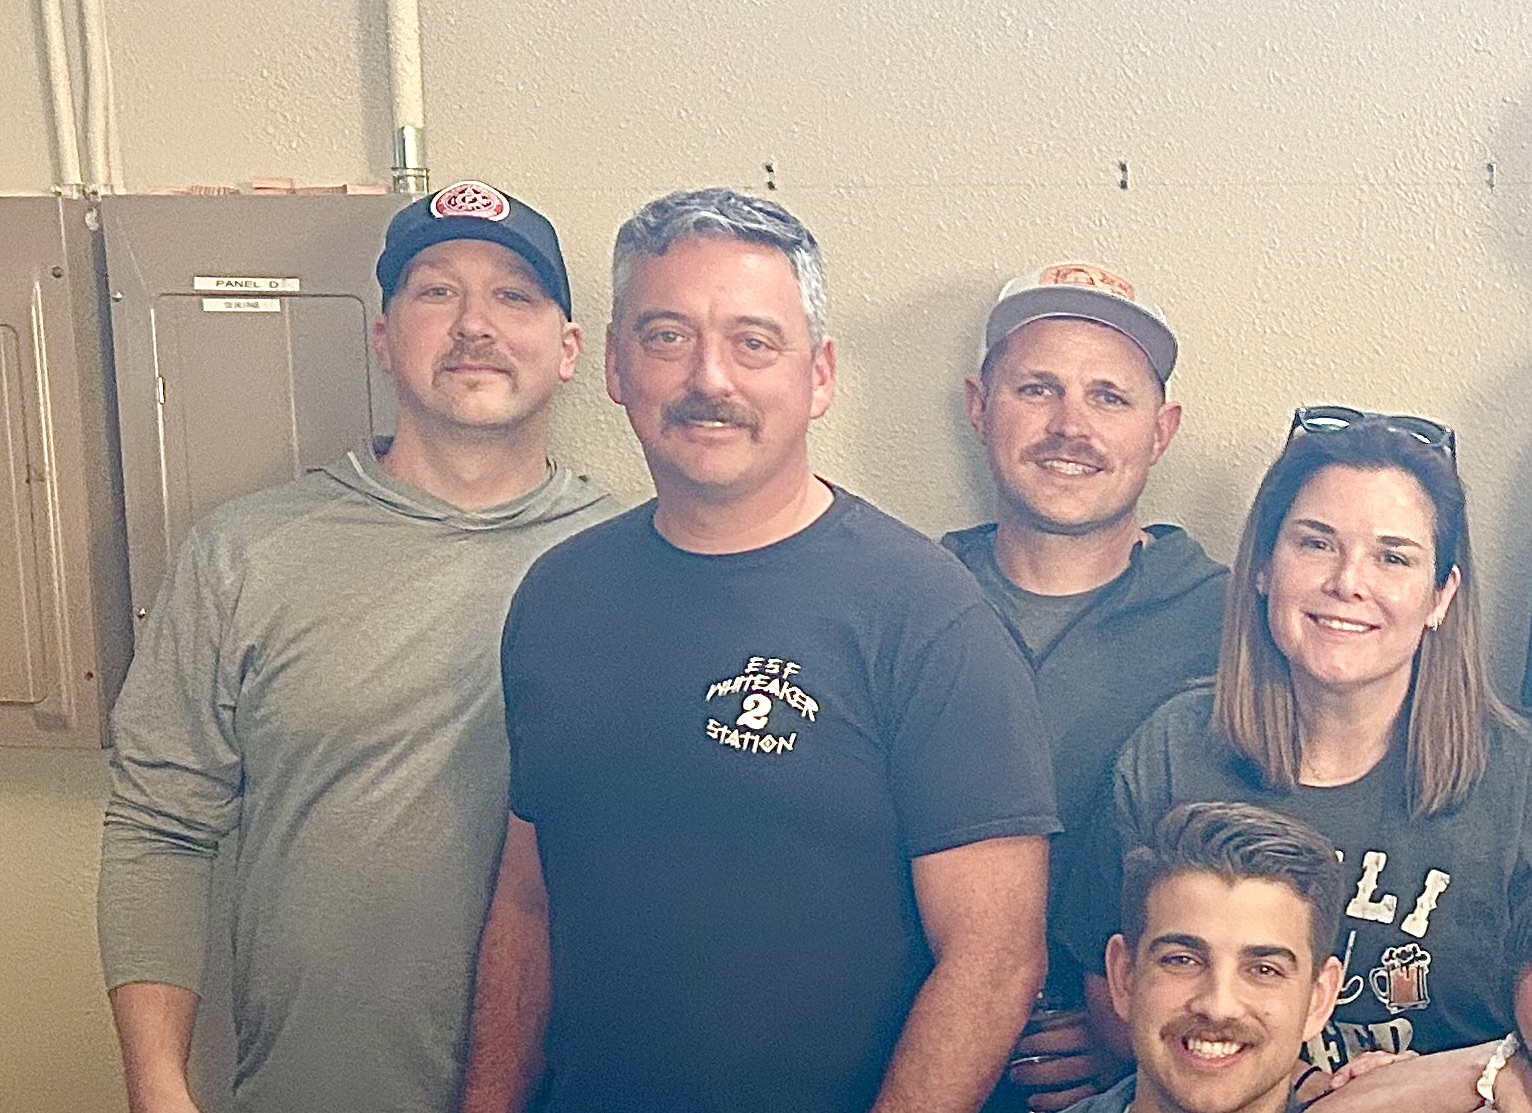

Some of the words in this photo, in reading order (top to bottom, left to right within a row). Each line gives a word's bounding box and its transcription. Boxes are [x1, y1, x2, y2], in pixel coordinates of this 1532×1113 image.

[215, 280, 261, 288] PANEL
[705, 674, 819, 722] WHITEAKER
[736, 693, 772, 730] 2
[706, 718, 797, 755] STATION
